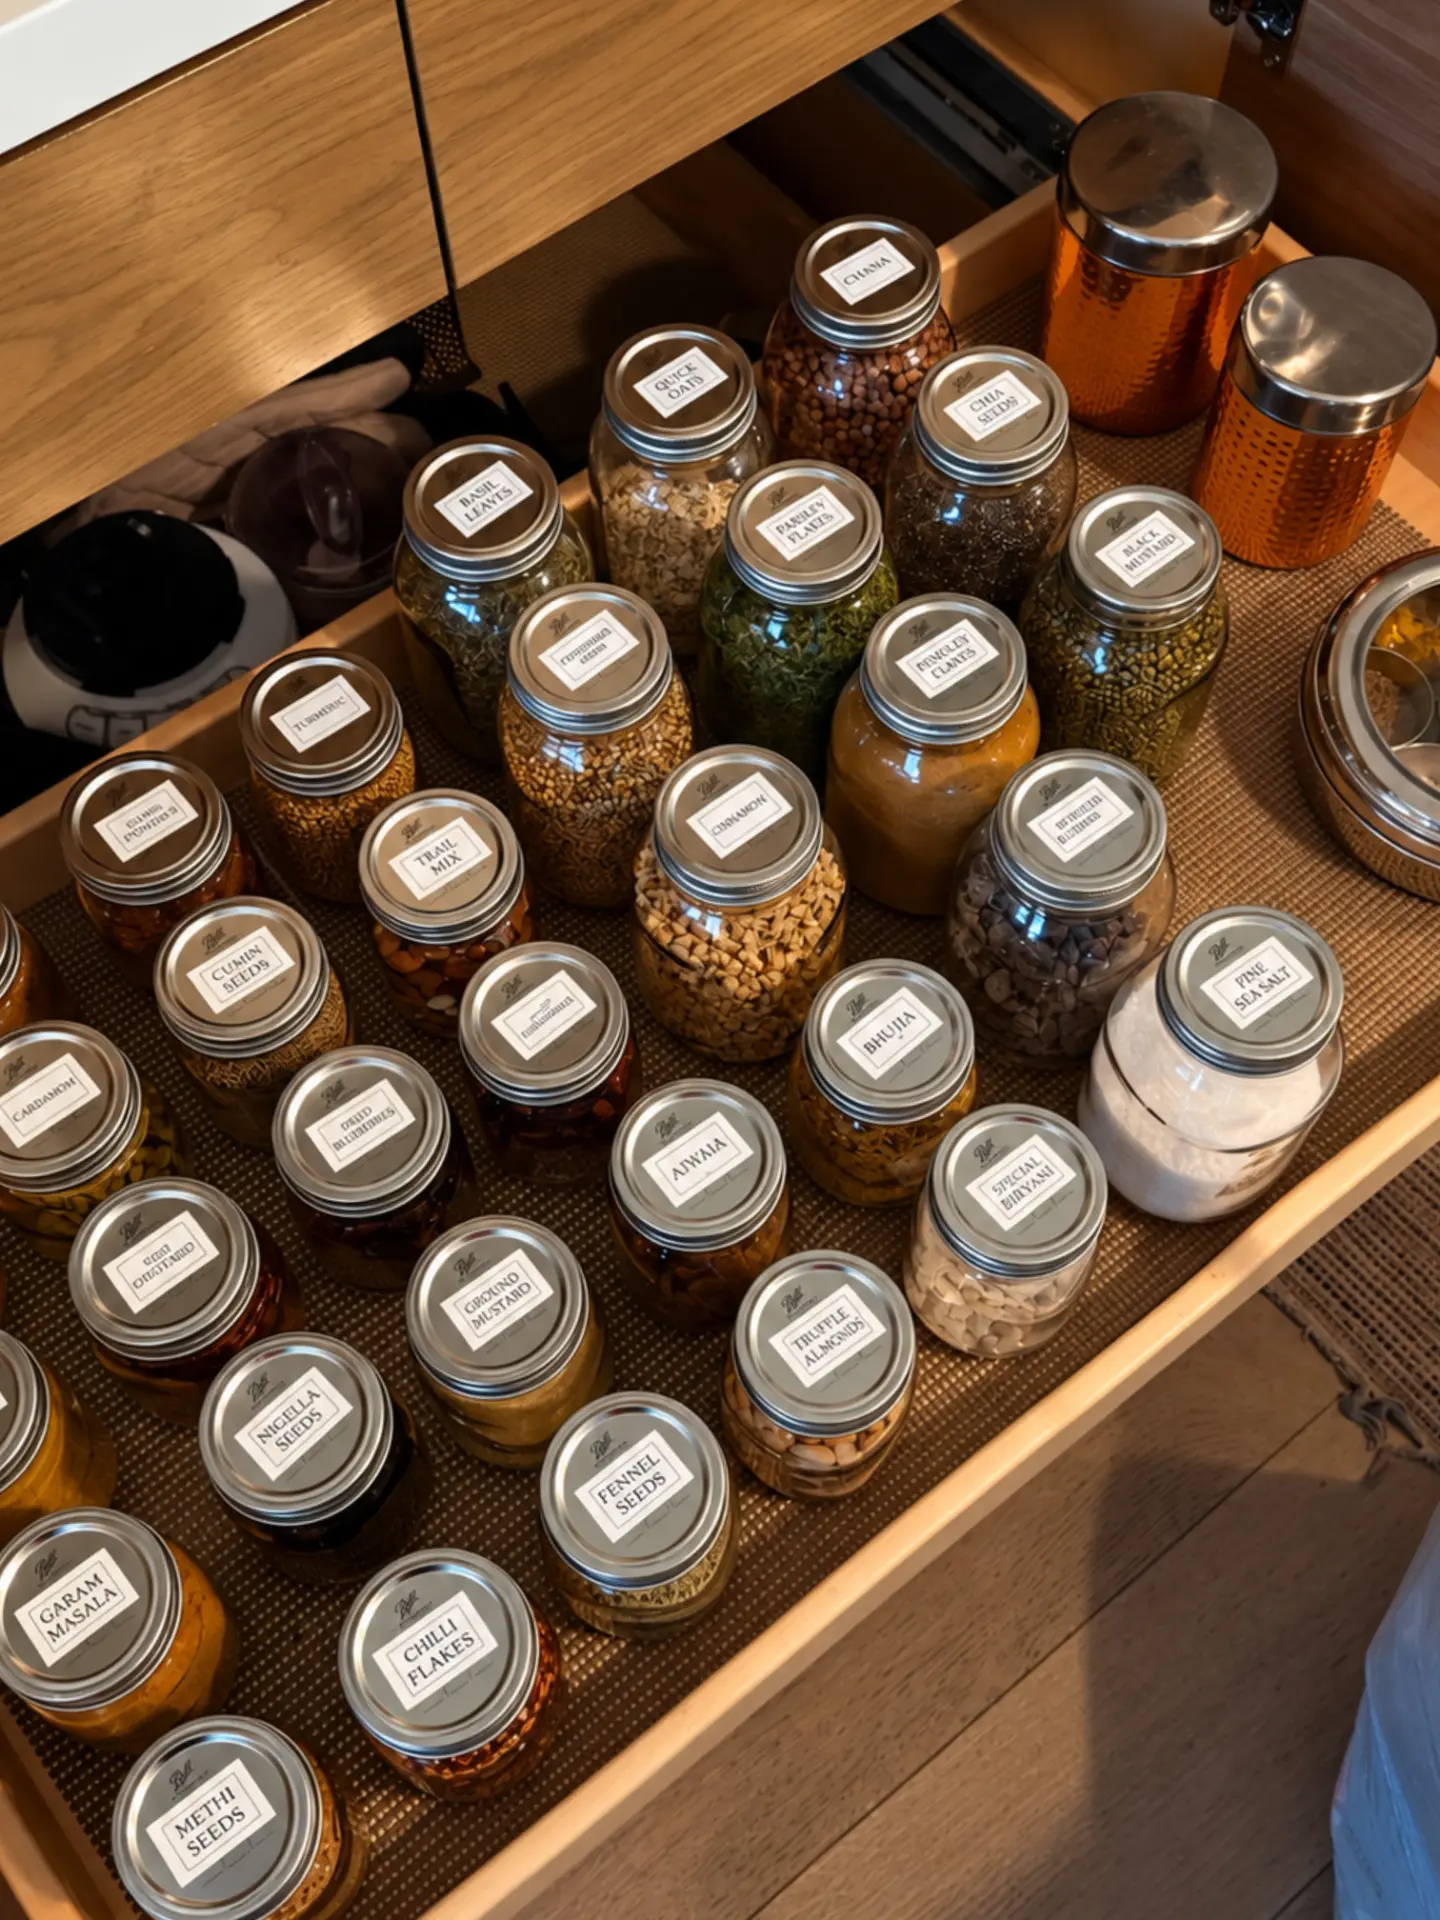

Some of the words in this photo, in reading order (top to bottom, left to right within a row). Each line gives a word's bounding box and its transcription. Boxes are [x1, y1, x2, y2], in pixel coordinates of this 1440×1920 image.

[654, 362, 698, 392] QUICK
[969, 389, 1005, 412] CHIA
[458, 480, 499, 508] BASIL
[1122, 530, 1160, 557] BLACK
[414, 838, 458, 866] TRAIL
[430, 850, 462, 876] MIX
[212, 944, 263, 981] CUMIN
[222, 959, 270, 993] SEEDS
[1234, 989, 1263, 1011] SEA
[1258, 965, 1291, 993] SALT
[863, 1011, 916, 1055] BHUJIA
[992, 1157, 1042, 1196] SPECIAL
[464, 1272, 520, 1314] GROUND
[471, 1282, 532, 1330] MUSTARD
[791, 1307, 850, 1351] TRUFFLE
[804, 1316, 865, 1367] ALMONDS
[256, 1390, 321, 1445] NIGELLA
[275, 1408, 323, 1452] SEEDS
[597, 1454, 660, 1504] FENNEL
[615, 1471, 666, 1515] SEEDS
[40, 1573, 103, 1624] GARAM
[47, 1588, 118, 1643] MASALA
[403, 1618, 458, 1663] CHILLI
[407, 1632, 475, 1687] FLAKES
[174, 1786, 236, 1840] METHI
[187, 1806, 245, 1857] SEEDS
